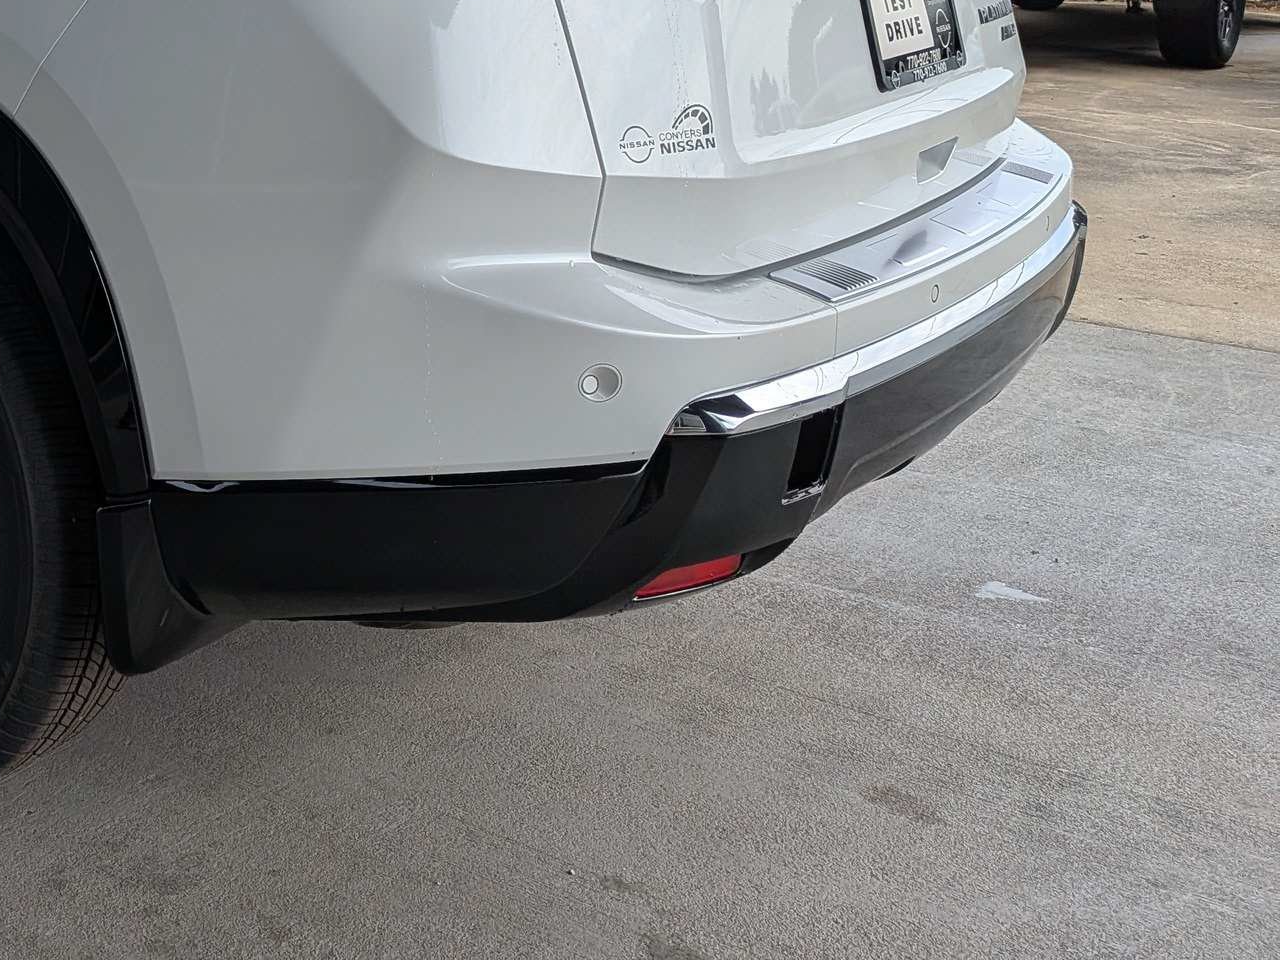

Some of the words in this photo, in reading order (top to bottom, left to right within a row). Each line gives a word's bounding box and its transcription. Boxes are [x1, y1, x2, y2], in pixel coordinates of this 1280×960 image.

[885, 16, 924, 42] DRIVE
[659, 129, 702, 142] CONYERS
[619, 140, 655, 150] NISSAN
[660, 137, 716, 155] NISSAN
